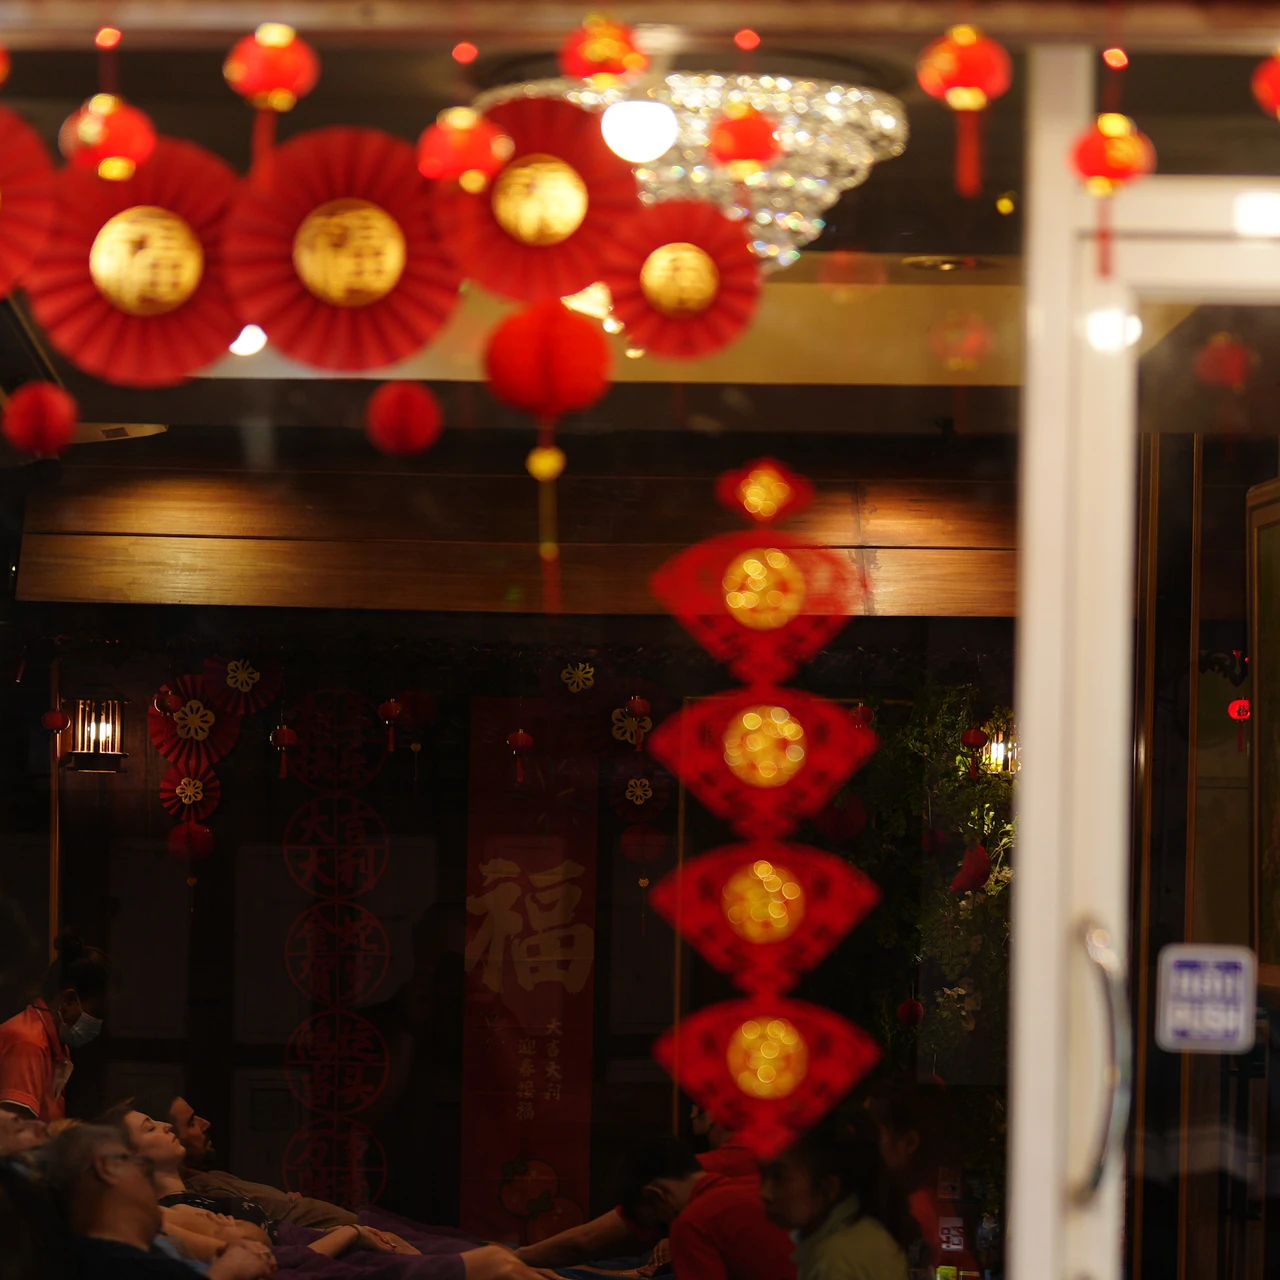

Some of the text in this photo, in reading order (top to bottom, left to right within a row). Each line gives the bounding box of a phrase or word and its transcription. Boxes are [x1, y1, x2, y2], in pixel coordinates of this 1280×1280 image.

[465, 857, 594, 995] 福
[515, 1037, 537, 1121] 迎春接福
[543, 1017, 564, 1102] 大吉大利
